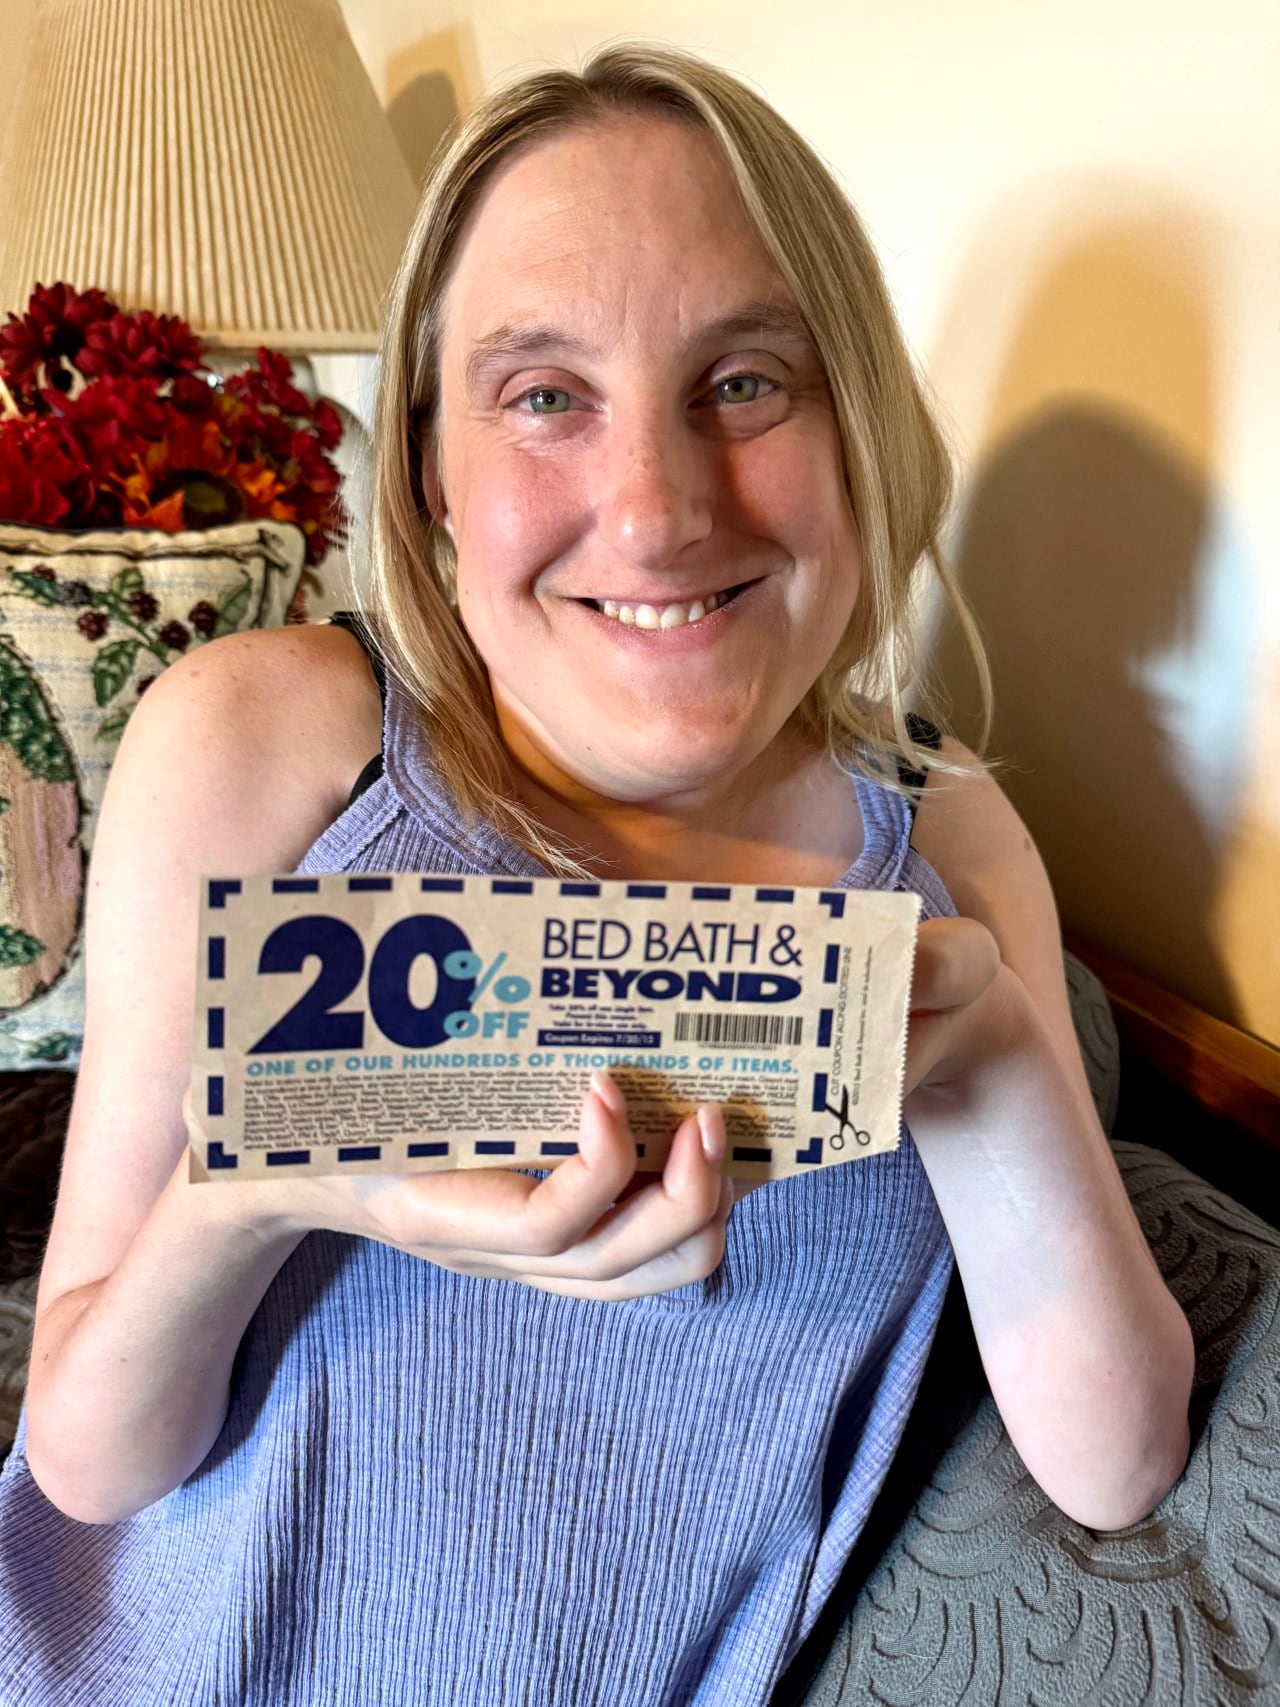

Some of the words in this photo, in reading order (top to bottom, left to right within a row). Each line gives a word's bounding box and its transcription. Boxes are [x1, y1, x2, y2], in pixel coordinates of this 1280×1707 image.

[543, 918, 632, 960] BED
[644, 921, 760, 965] BATH
[769, 924, 803, 967] &
[540, 966, 803, 1004] BEYOND
[839, 966, 850, 999] DOTTED
[442, 1010, 530, 1039] OFF
[836, 1001, 847, 1033] ALONG
[544, 1032, 580, 1043] Coupon
[246, 1060, 296, 1077] ONE
[304, 1058, 335, 1073] OF
[344, 1055, 393, 1072] OUR
[401, 1053, 520, 1069] HUNDREDS
[527, 1052, 555, 1068] OF
[563, 1053, 690, 1071] THOUSANDS
[697, 1056, 725, 1072] OF
[731, 1056, 799, 1075] ITEMS.
[831, 1034, 843, 1076] COUPON
[831, 1077, 841, 1096] CUT
